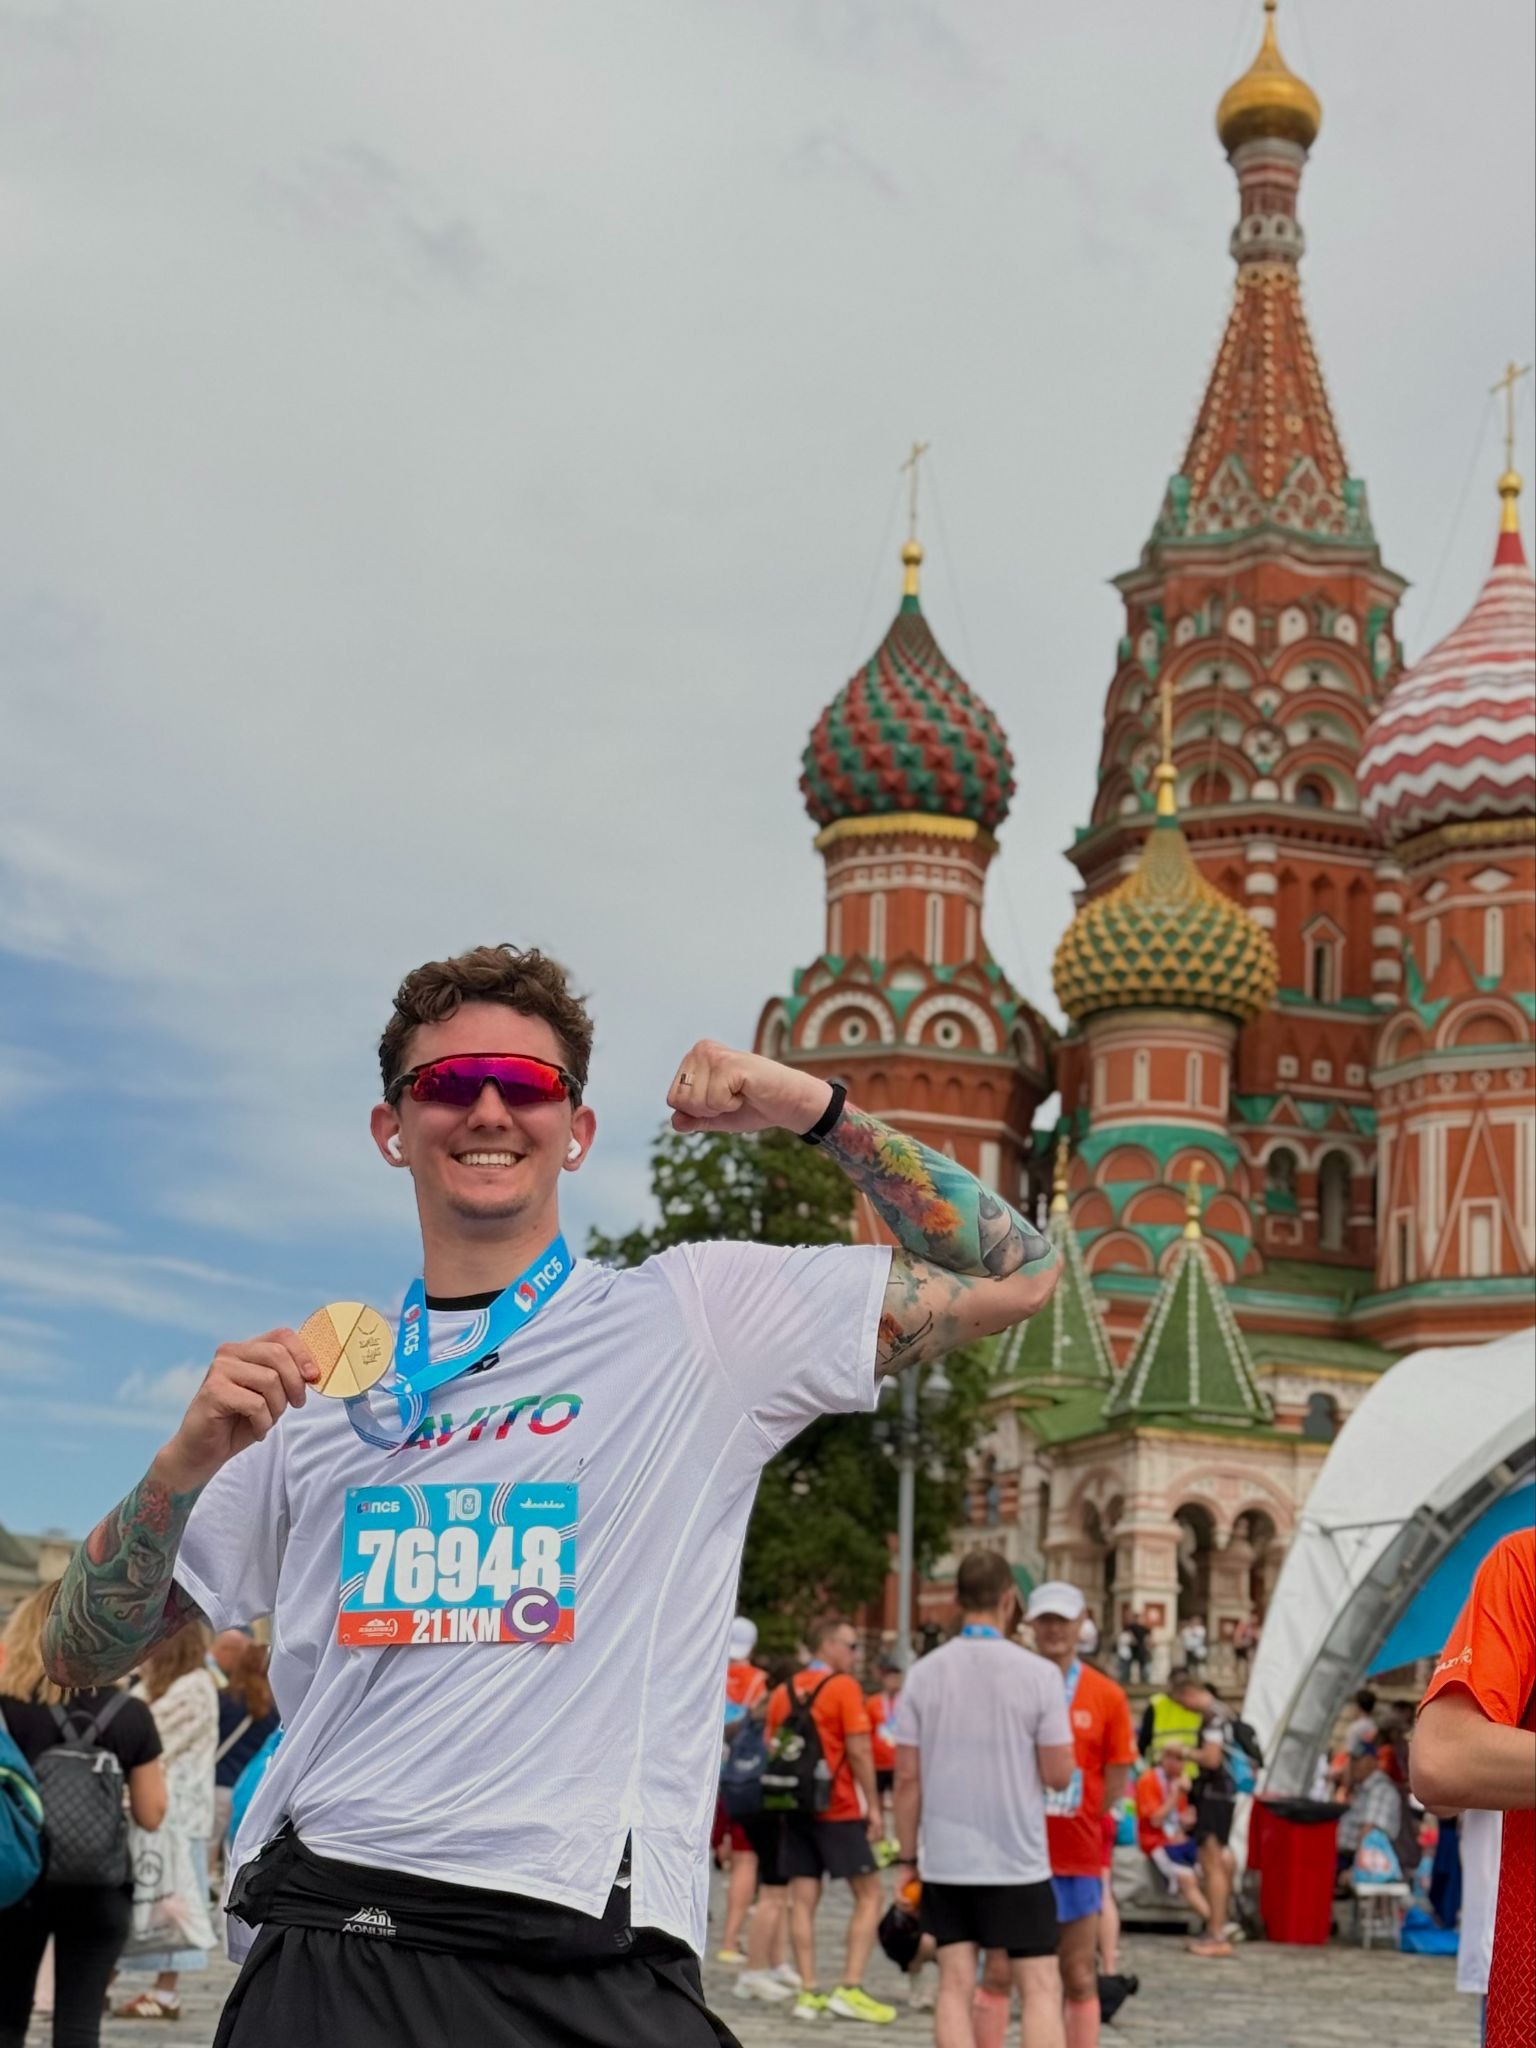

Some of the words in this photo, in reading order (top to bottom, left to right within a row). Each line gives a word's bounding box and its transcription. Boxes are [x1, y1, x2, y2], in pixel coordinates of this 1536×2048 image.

[534, 1256, 564, 1291] ПСБ
[404, 1320, 419, 1356] ПСБ
[371, 1501, 400, 1513] ПСБ
[445, 1488, 481, 1521] 10
[357, 1526, 561, 1604] 76948
[411, 1608, 500, 1643] 21.1KM
[512, 1594, 550, 1633] C
